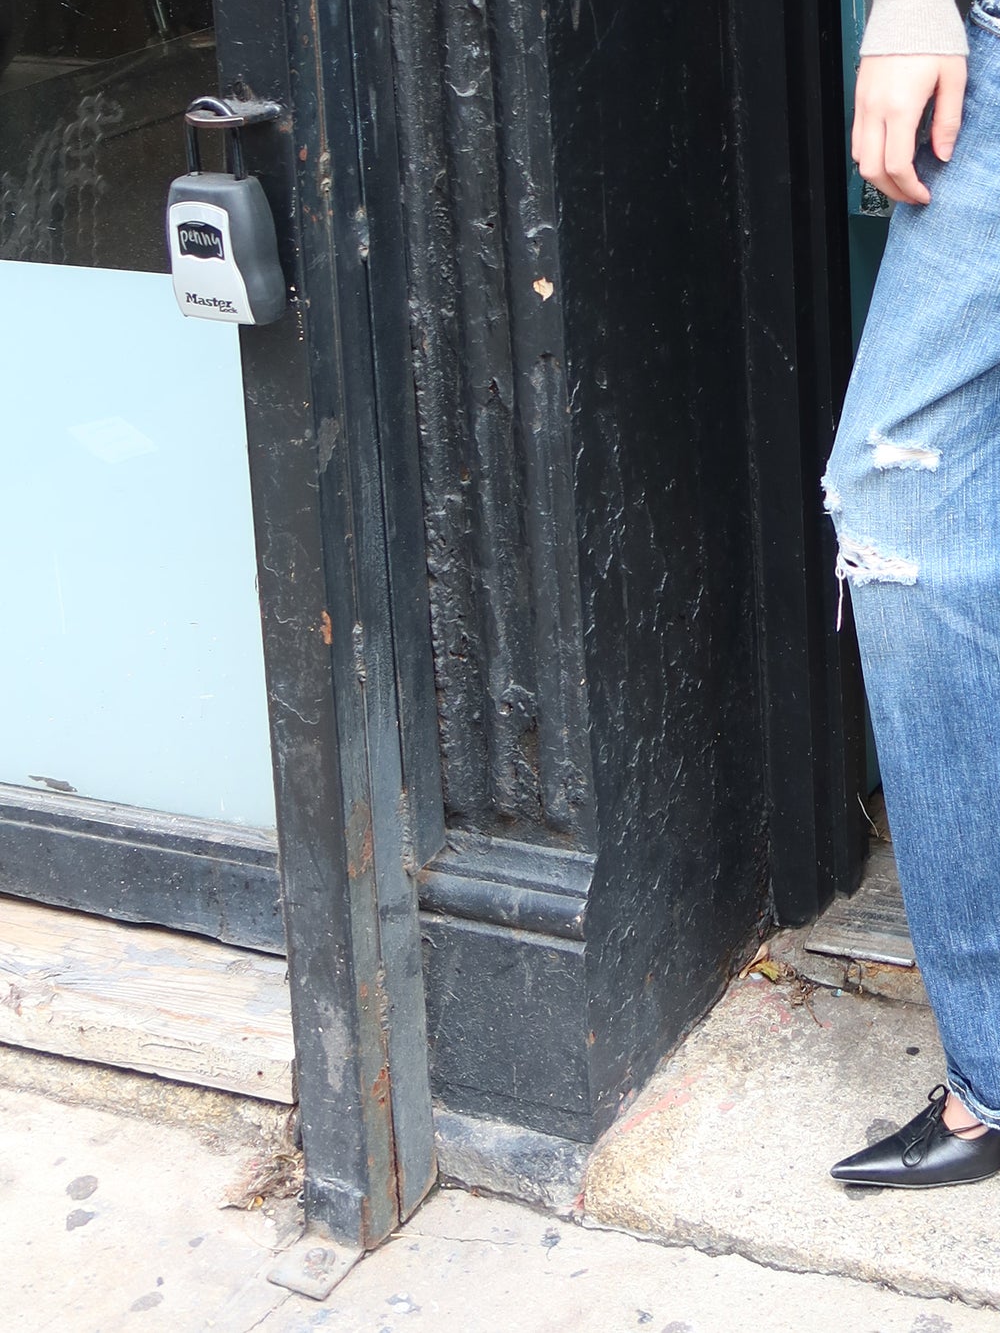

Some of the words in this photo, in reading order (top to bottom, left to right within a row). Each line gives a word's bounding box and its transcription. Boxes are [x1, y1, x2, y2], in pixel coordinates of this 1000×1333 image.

[180, 228, 223, 258] penny
[185, 291, 233, 308] Master
[219, 305, 238, 315] Lock
